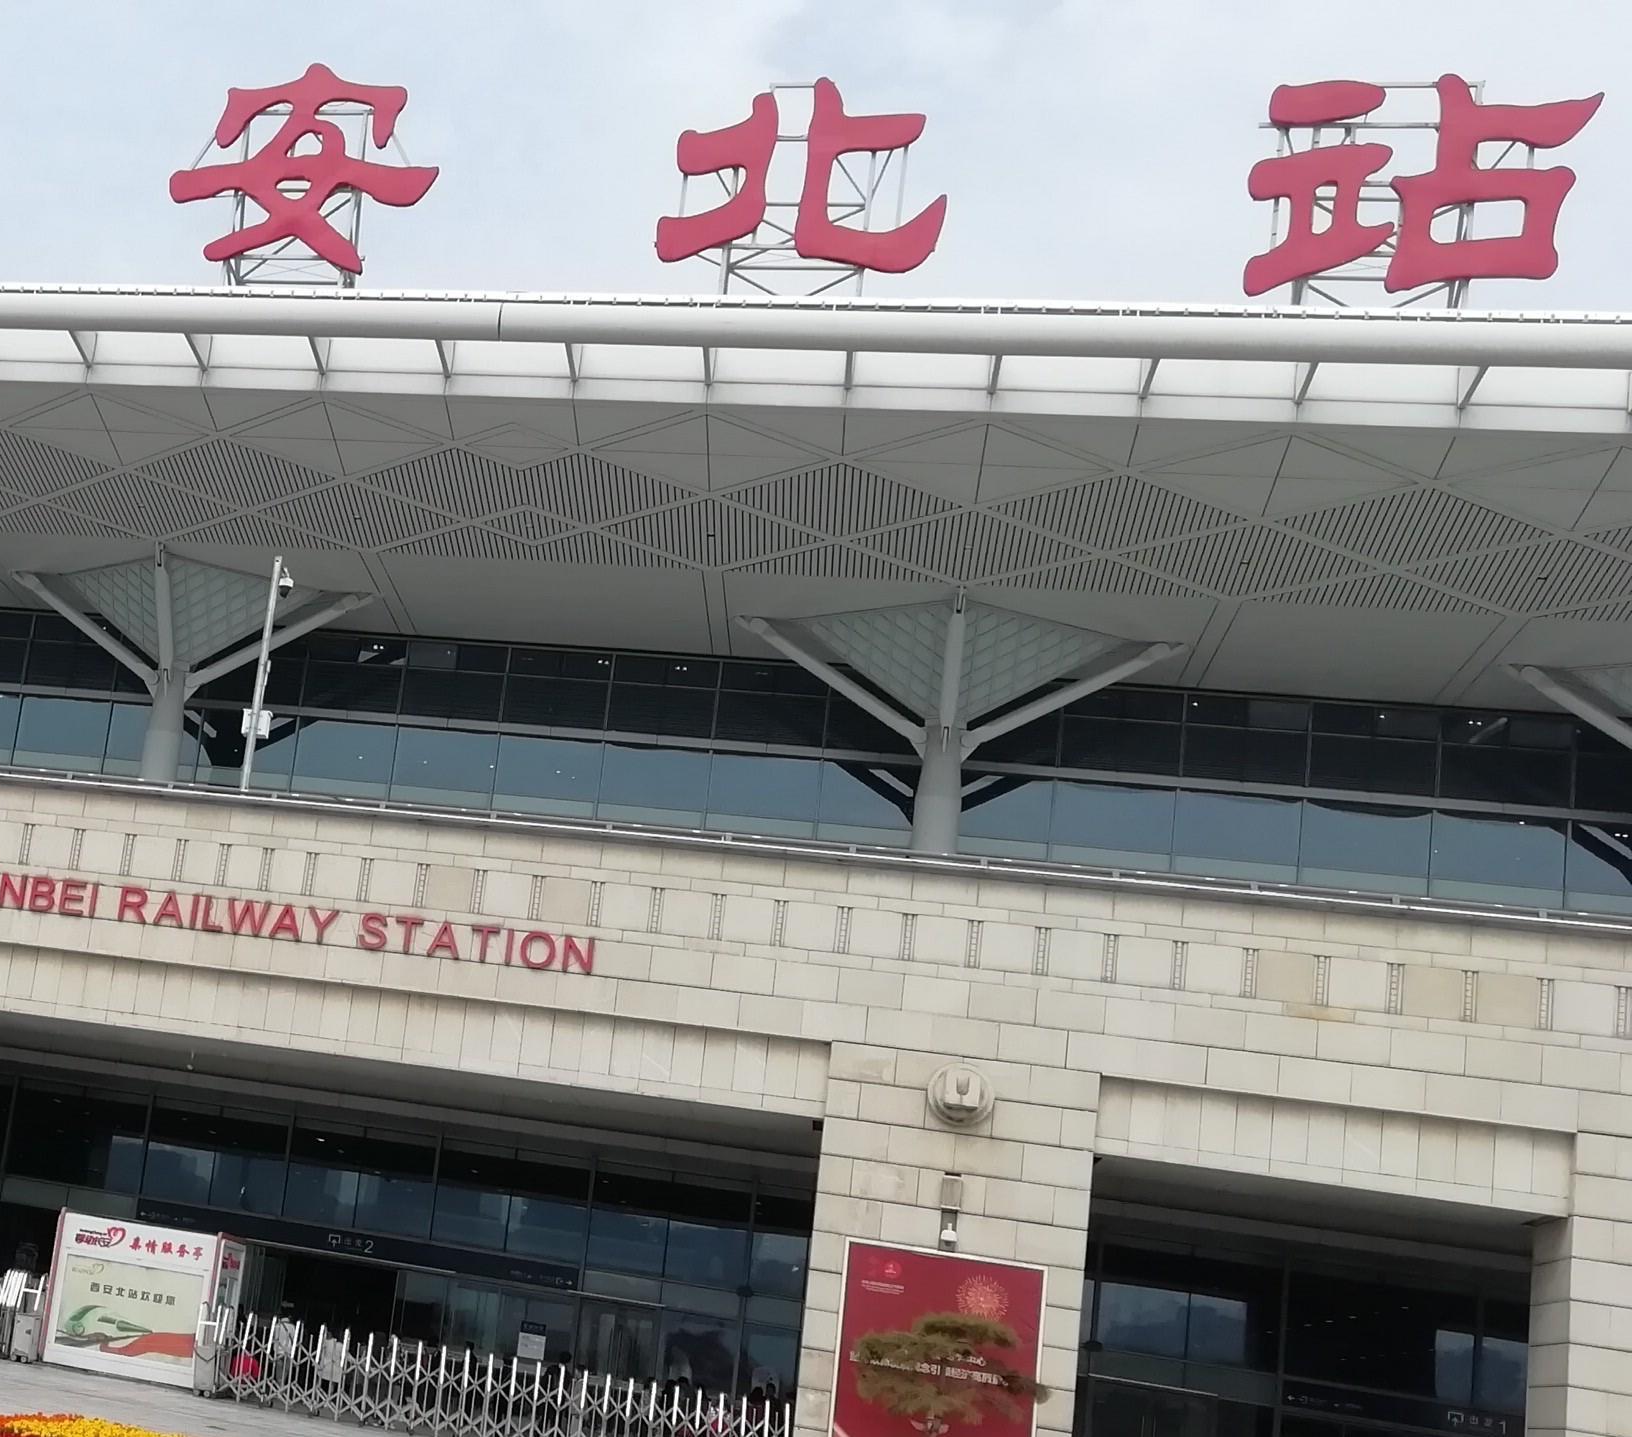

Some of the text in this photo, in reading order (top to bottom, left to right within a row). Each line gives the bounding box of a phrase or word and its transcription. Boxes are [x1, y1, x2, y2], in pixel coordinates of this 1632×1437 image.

[116, 884, 342, 943] RAILWAY
[357, 911, 599, 975] STATION
[364, 1239, 374, 1254] 2
[89, 1281, 176, 1306] 西安北站欢迎您
